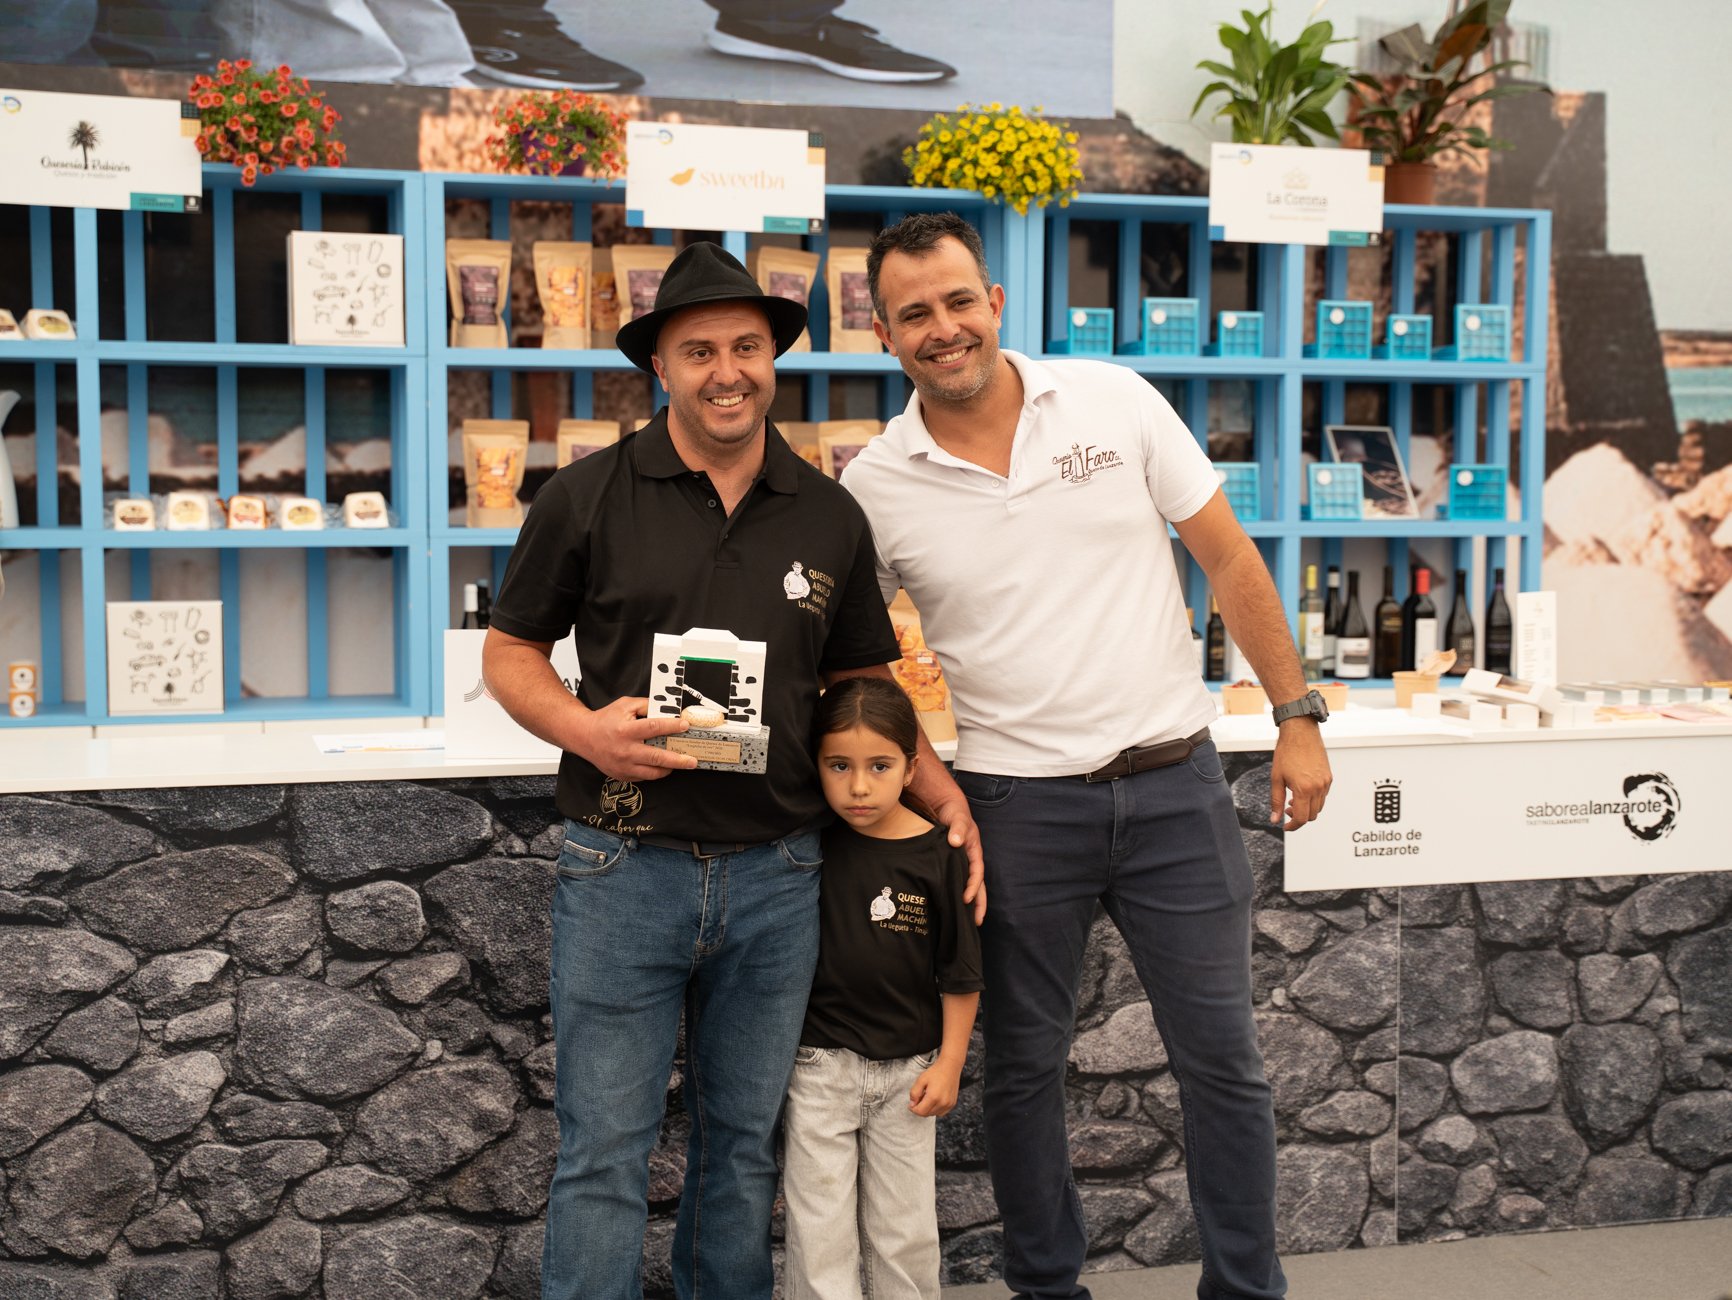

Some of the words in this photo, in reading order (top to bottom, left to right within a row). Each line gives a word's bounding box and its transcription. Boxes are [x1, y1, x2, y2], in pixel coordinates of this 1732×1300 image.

[700, 169, 785, 191] sweetba
[1266, 192, 1281, 205] La
[1061, 459, 1074, 479] El
[1085, 445, 1117, 470] Faro
[798, 600, 806, 609] La
[1352, 830, 1402, 843] Cabildo
[1406, 829, 1422, 840] de
[1354, 844, 1420, 857] Lanzarote
[897, 892, 926, 905] QUESE
[898, 903, 925, 915] ABUEL
